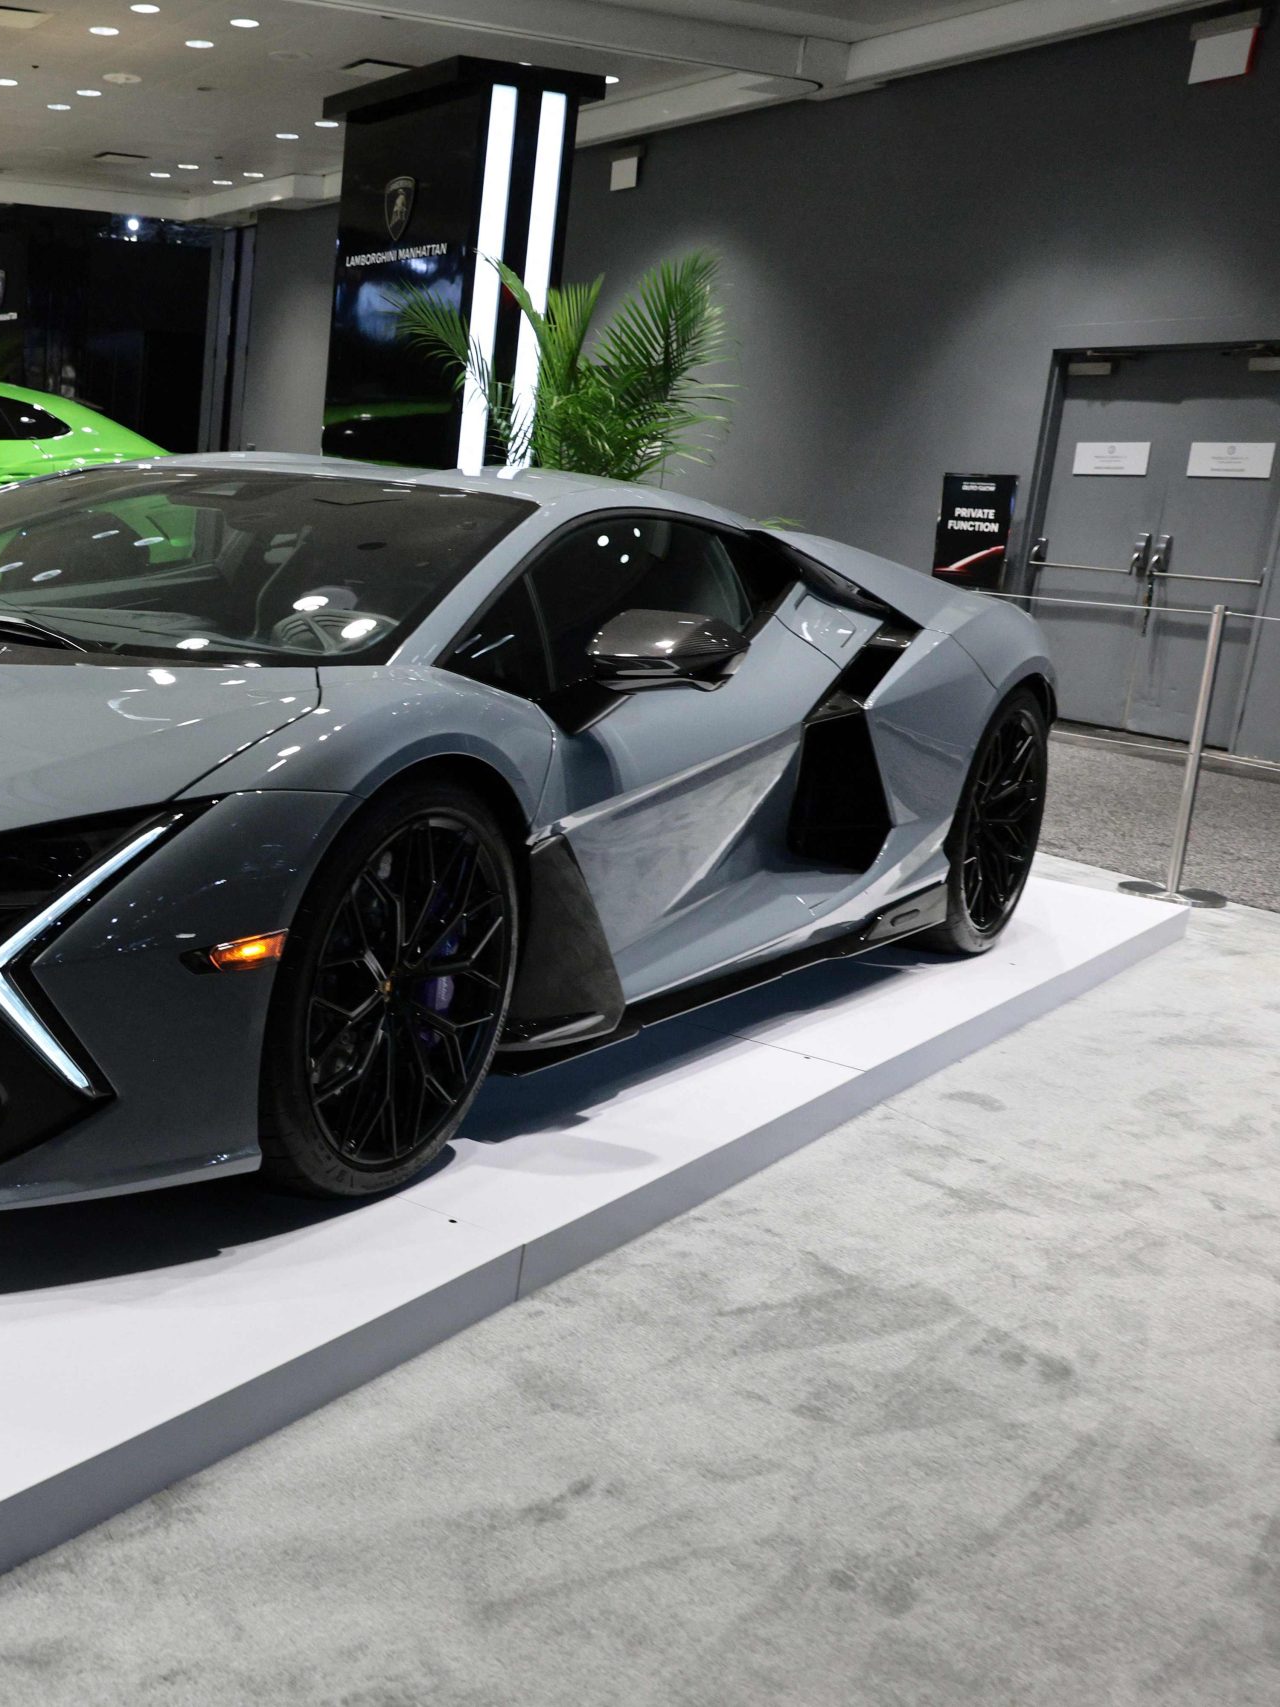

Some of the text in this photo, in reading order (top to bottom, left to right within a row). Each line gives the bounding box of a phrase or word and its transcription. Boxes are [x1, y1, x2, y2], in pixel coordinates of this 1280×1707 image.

[346, 243, 448, 267] LAMBORGHINI MANHATTAN
[954, 507, 996, 519] PRIVATE
[947, 520, 1000, 533] FUNCTION
